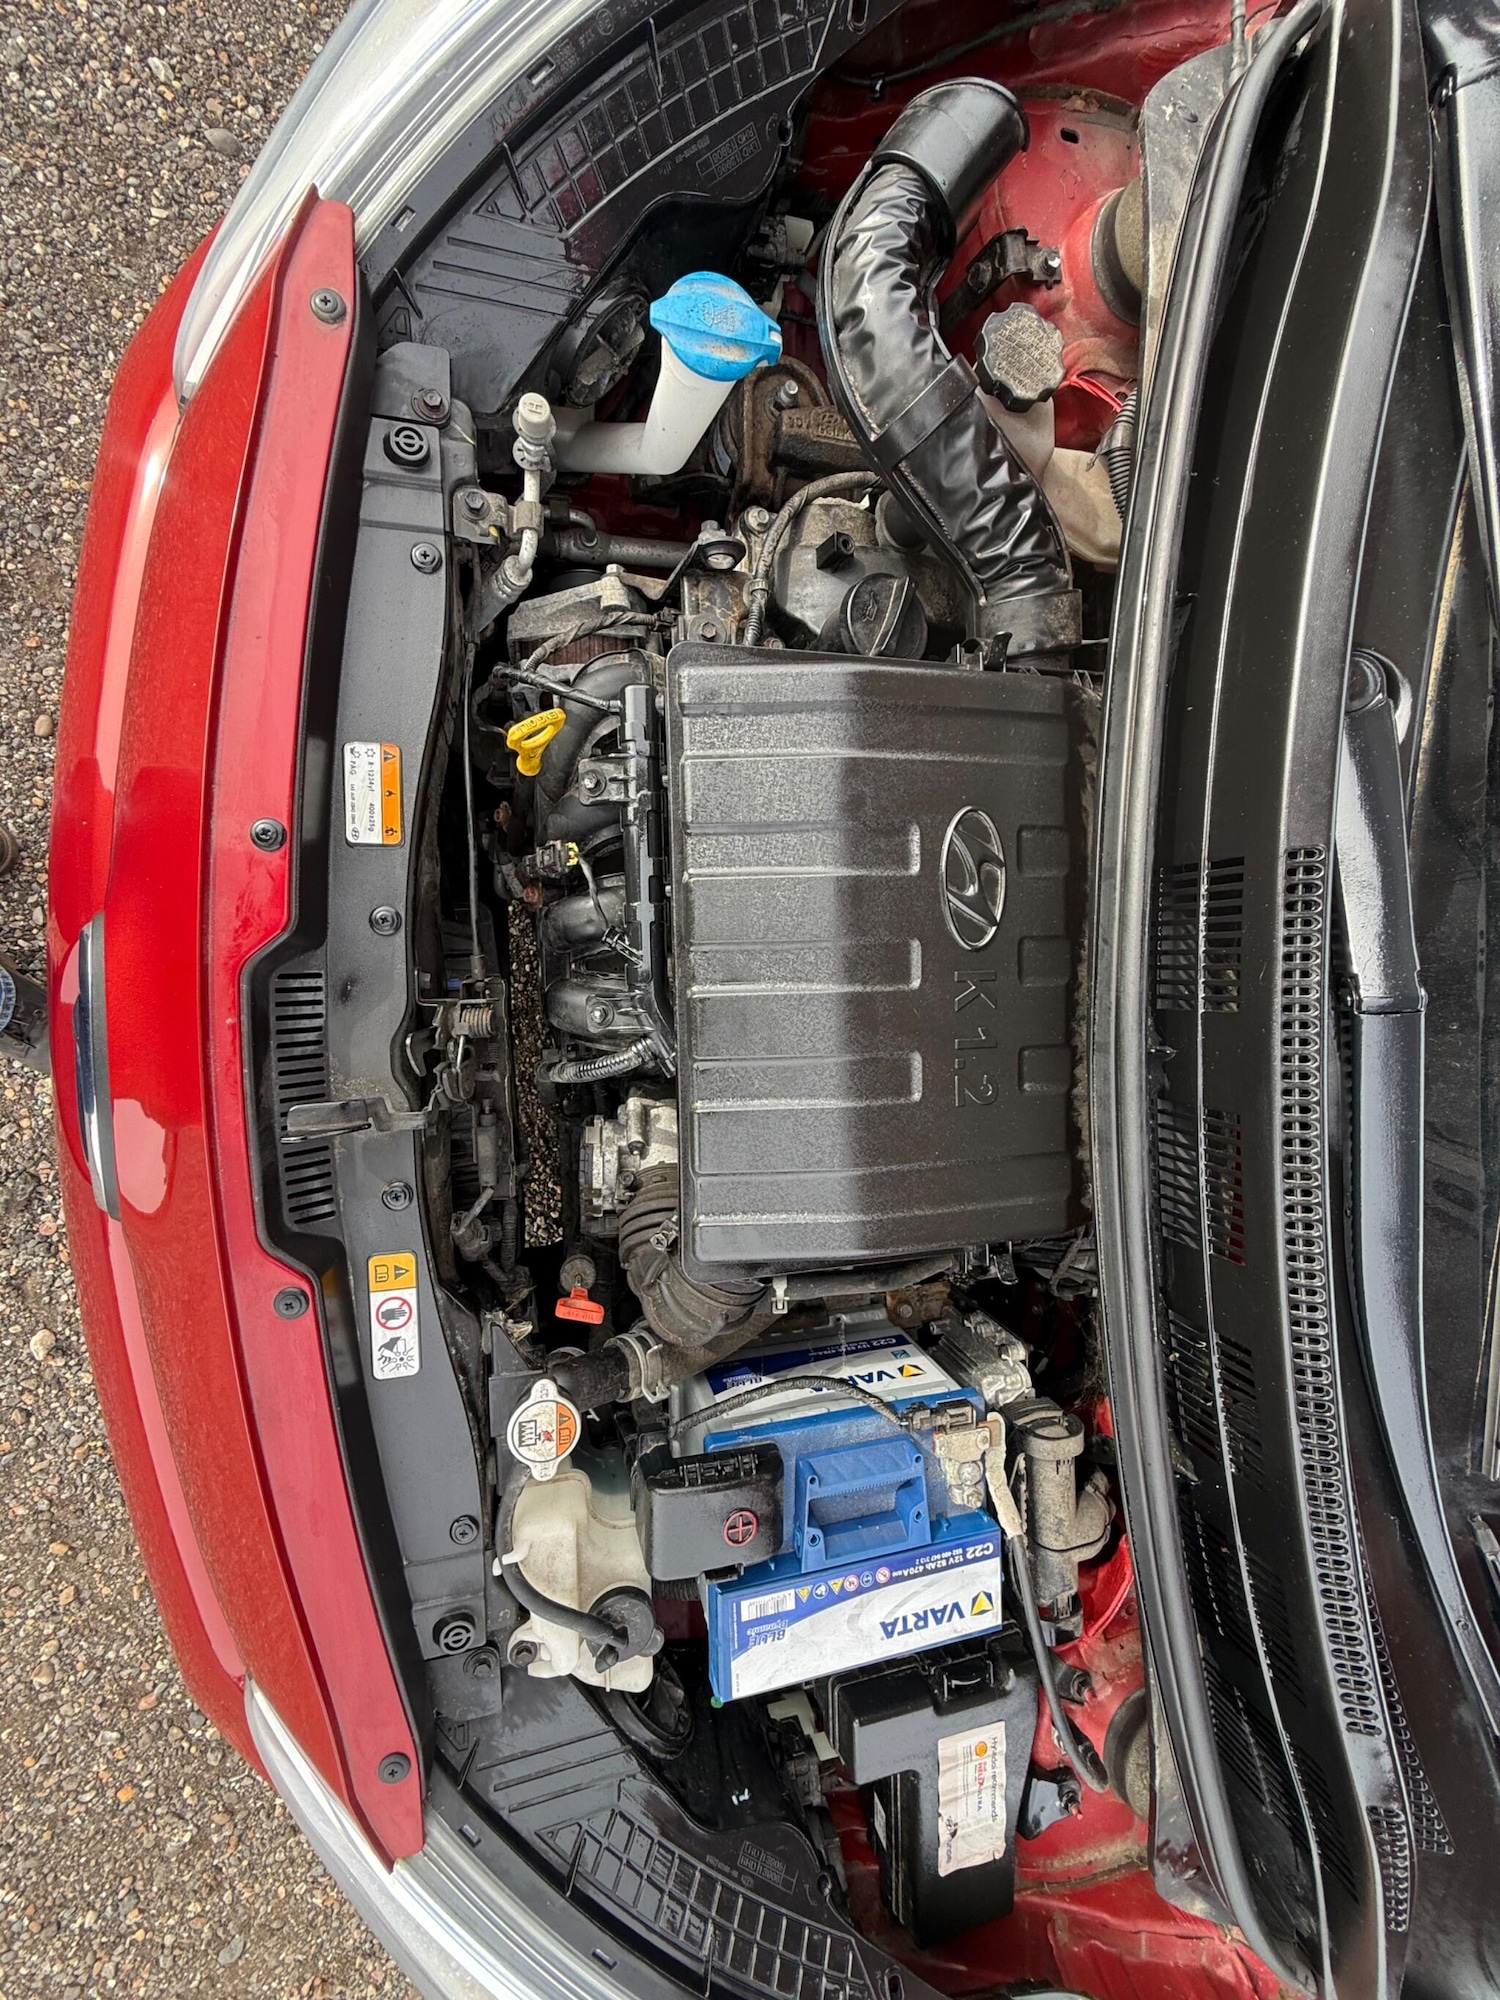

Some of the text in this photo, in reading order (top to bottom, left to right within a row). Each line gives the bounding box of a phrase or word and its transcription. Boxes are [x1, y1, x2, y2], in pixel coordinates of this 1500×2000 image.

[966, 1542, 994, 1559] C22
[925, 1559, 947, 1570] 52Ah
[948, 1555, 963, 1565] 12V
[880, 1601, 965, 1640] VARTA
[748, 1629, 785, 1648] BLUE
[990, 1737, 998, 1769] Hyundai
